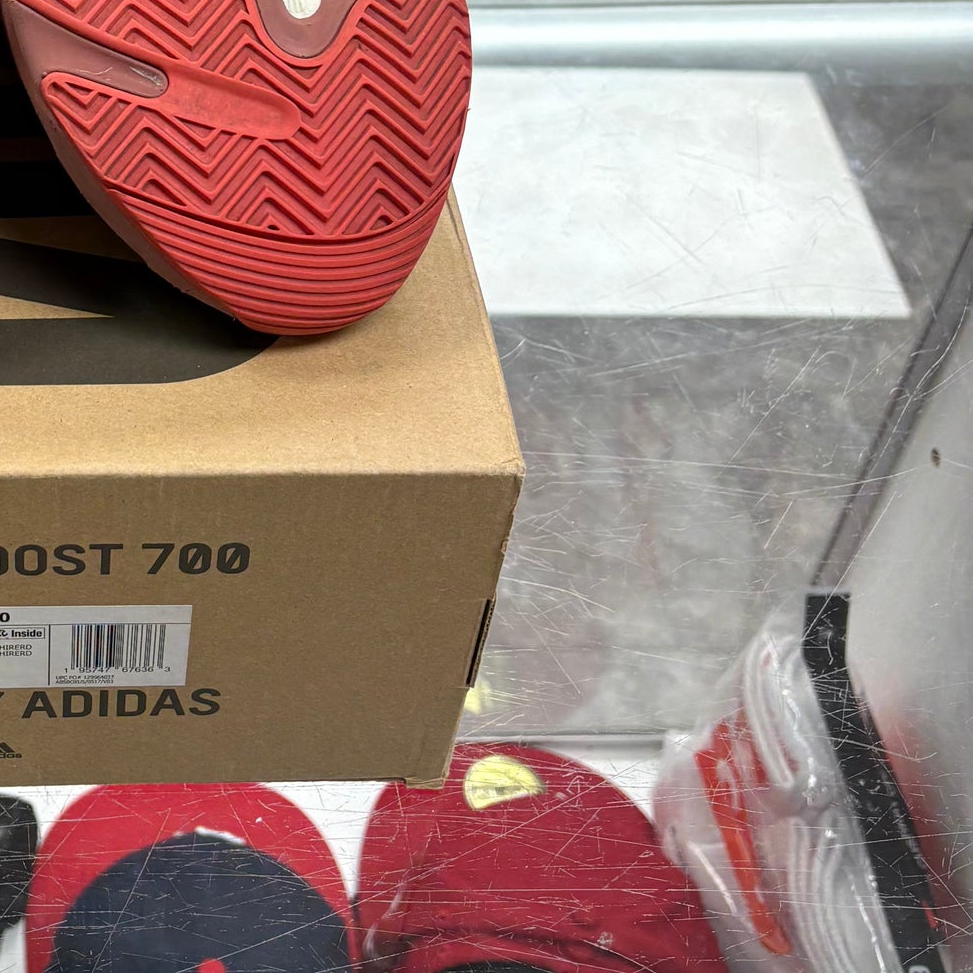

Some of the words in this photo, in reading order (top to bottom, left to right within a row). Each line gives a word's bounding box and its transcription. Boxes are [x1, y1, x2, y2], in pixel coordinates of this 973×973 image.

[141, 542, 251, 575] 700
[11, 629, 43, 638] Inside
[21, 688, 222, 719] ADIDAS
